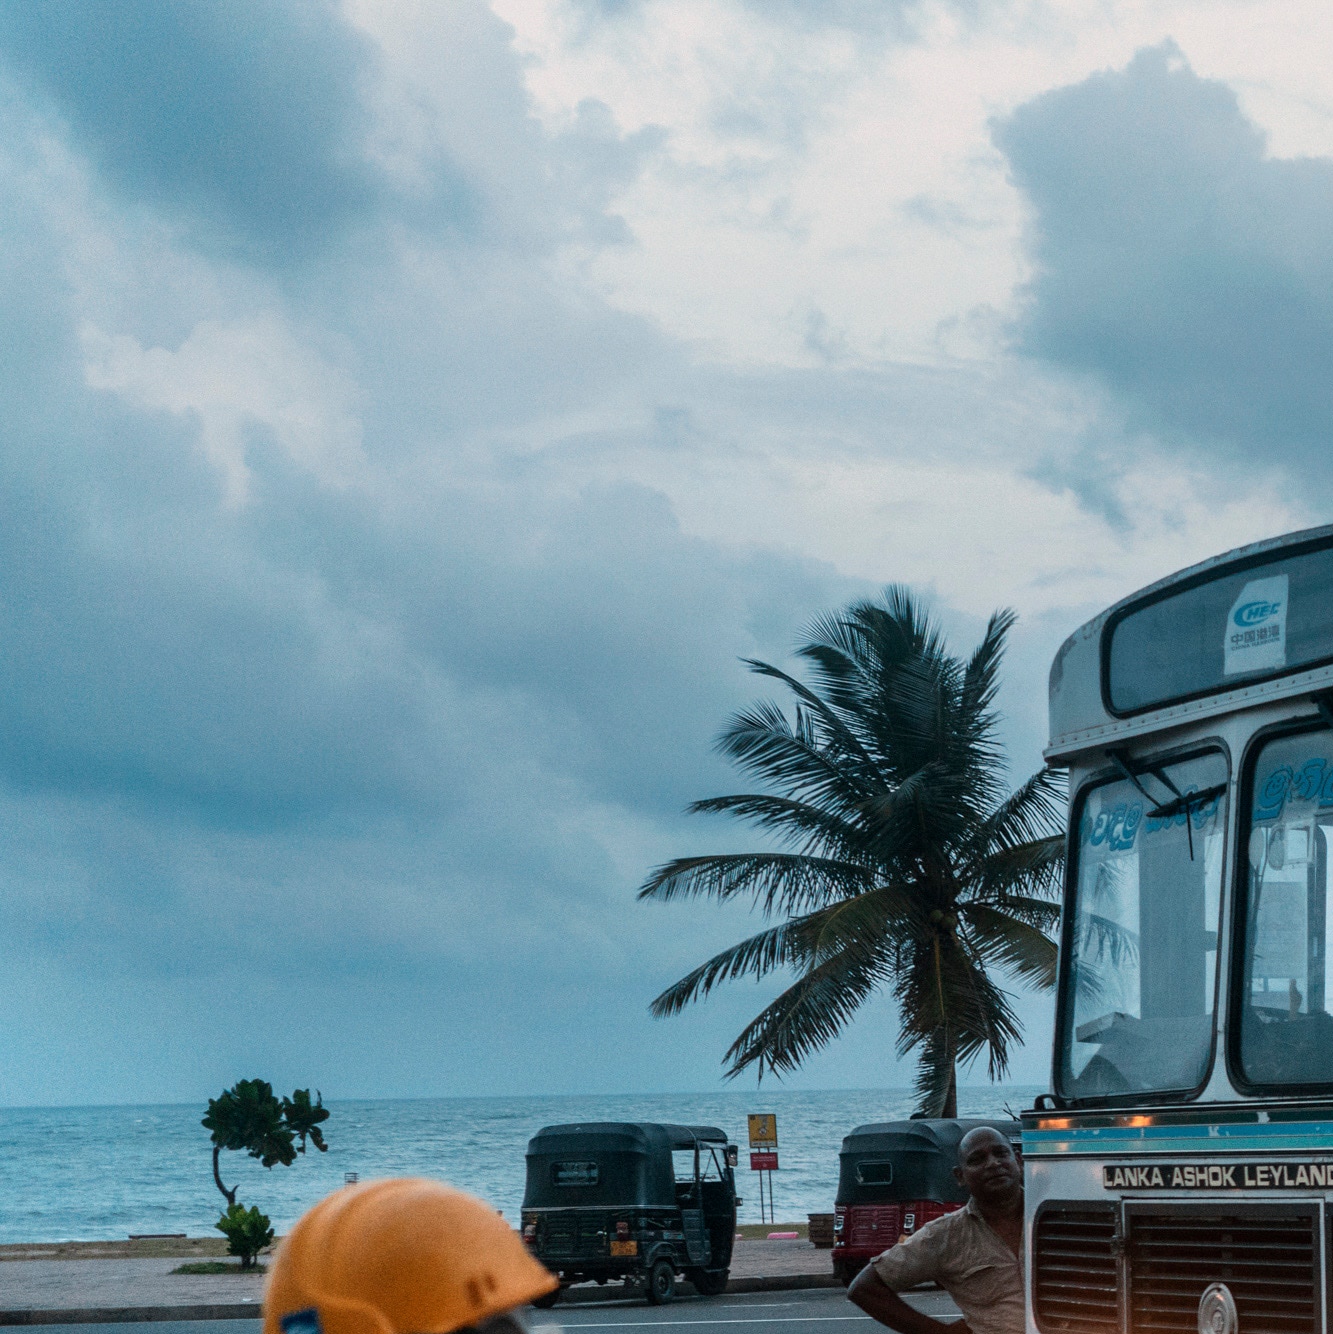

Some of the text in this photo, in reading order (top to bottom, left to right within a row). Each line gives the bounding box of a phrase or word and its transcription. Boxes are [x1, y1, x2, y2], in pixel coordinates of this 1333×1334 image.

[1233, 601, 1281, 628] CHEC
[1103, 1166, 1164, 1188] LANKA
[1171, 1166, 1236, 1187] ASHOK
